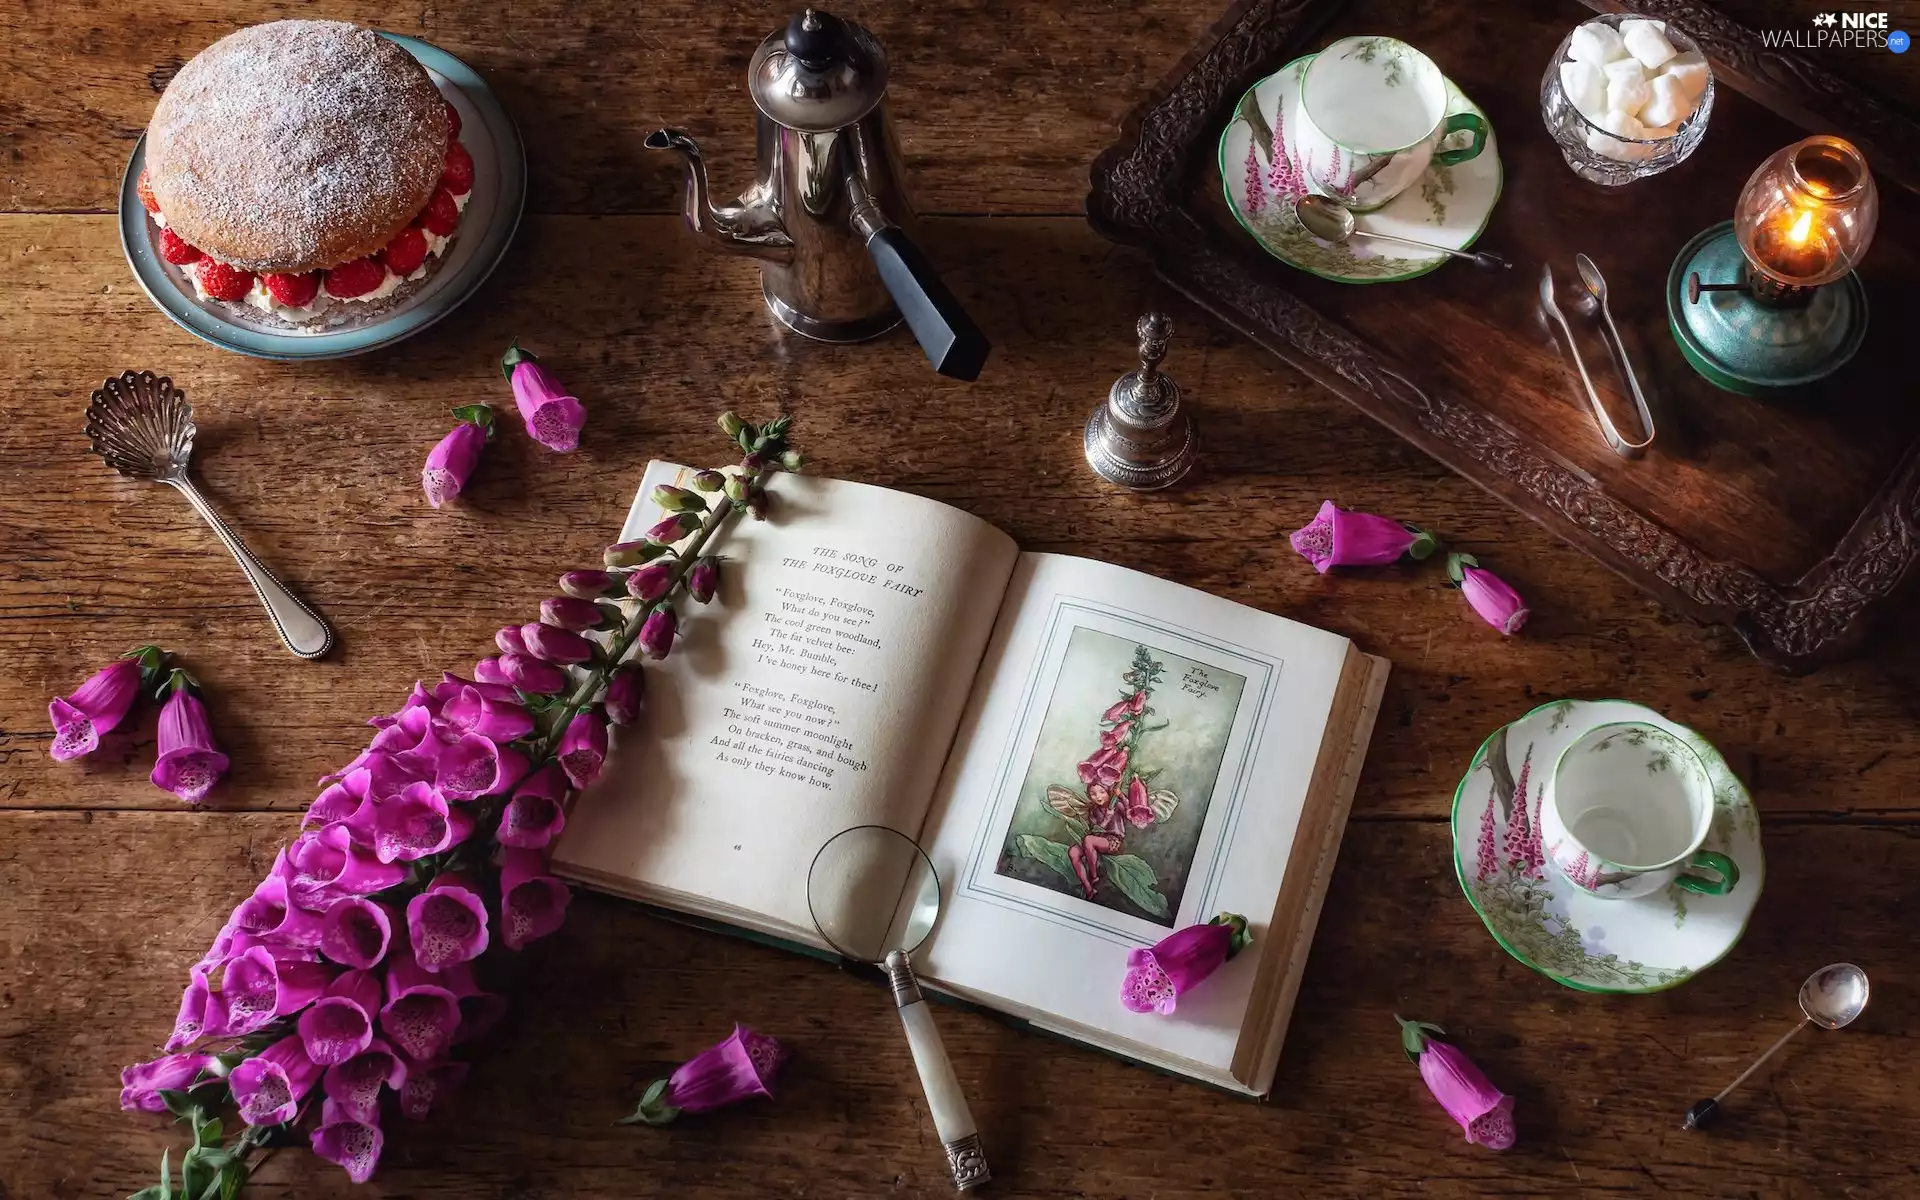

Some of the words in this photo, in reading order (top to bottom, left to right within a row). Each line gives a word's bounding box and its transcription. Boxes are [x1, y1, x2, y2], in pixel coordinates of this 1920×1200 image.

[813, 546, 839, 558] THE
[842, 552, 878, 568] SONG
[886, 563, 904, 573] OF
[782, 557, 807, 569] THE
[812, 563, 877, 584] FOXGLOVE
[882, 579, 923, 597] FAIRY
[782, 602, 806, 614] What
[808, 607, 819, 616] do
[822, 612, 840, 621] you
[830, 597, 875, 618] Foxglove,
[764, 612, 782, 623] The
[784, 619, 804, 627] cool
[805, 623, 831, 634] green
[835, 630, 881, 650] woodland,
[770, 628, 788, 639] The
[790, 632, 802, 642] fat
[806, 637, 833, 650] velvet
[752, 638, 774, 652] Hey,
[778, 643, 795, 656] Mr.
[799, 648, 837, 667] Bumble,
[780, 658, 808, 675] honey
[811, 665, 831, 678] here
[834, 671, 848, 683] for
[1182, 673, 1220, 692] Foxglove
[1190, 666, 1208, 679] The
[740, 697, 765, 711] What
[767, 705, 782, 714] see
[783, 709, 802, 719] you
[790, 693, 836, 716] Foxglove,
[723, 707, 741, 720] The
[743, 714, 761, 724] soft
[763, 719, 801, 734] summer
[803, 729, 854, 751] moonlight
[710, 735, 732, 747] And
[732, 741, 746, 751] all
[747, 744, 763, 755] the
[765, 748, 794, 763] fairies
[796, 757, 835, 778] dancing
[728, 724, 743, 735] On
[745, 727, 784, 746] bracken,
[786, 740, 812, 754] grass,
[816, 748, 835, 759] and
[837, 753, 868, 772] bough
[716, 751, 729, 762] As
[731, 757, 752, 770] only
[754, 761, 777, 776] they
[778, 766, 806, 782] know
[808, 775, 832, 791] how.
